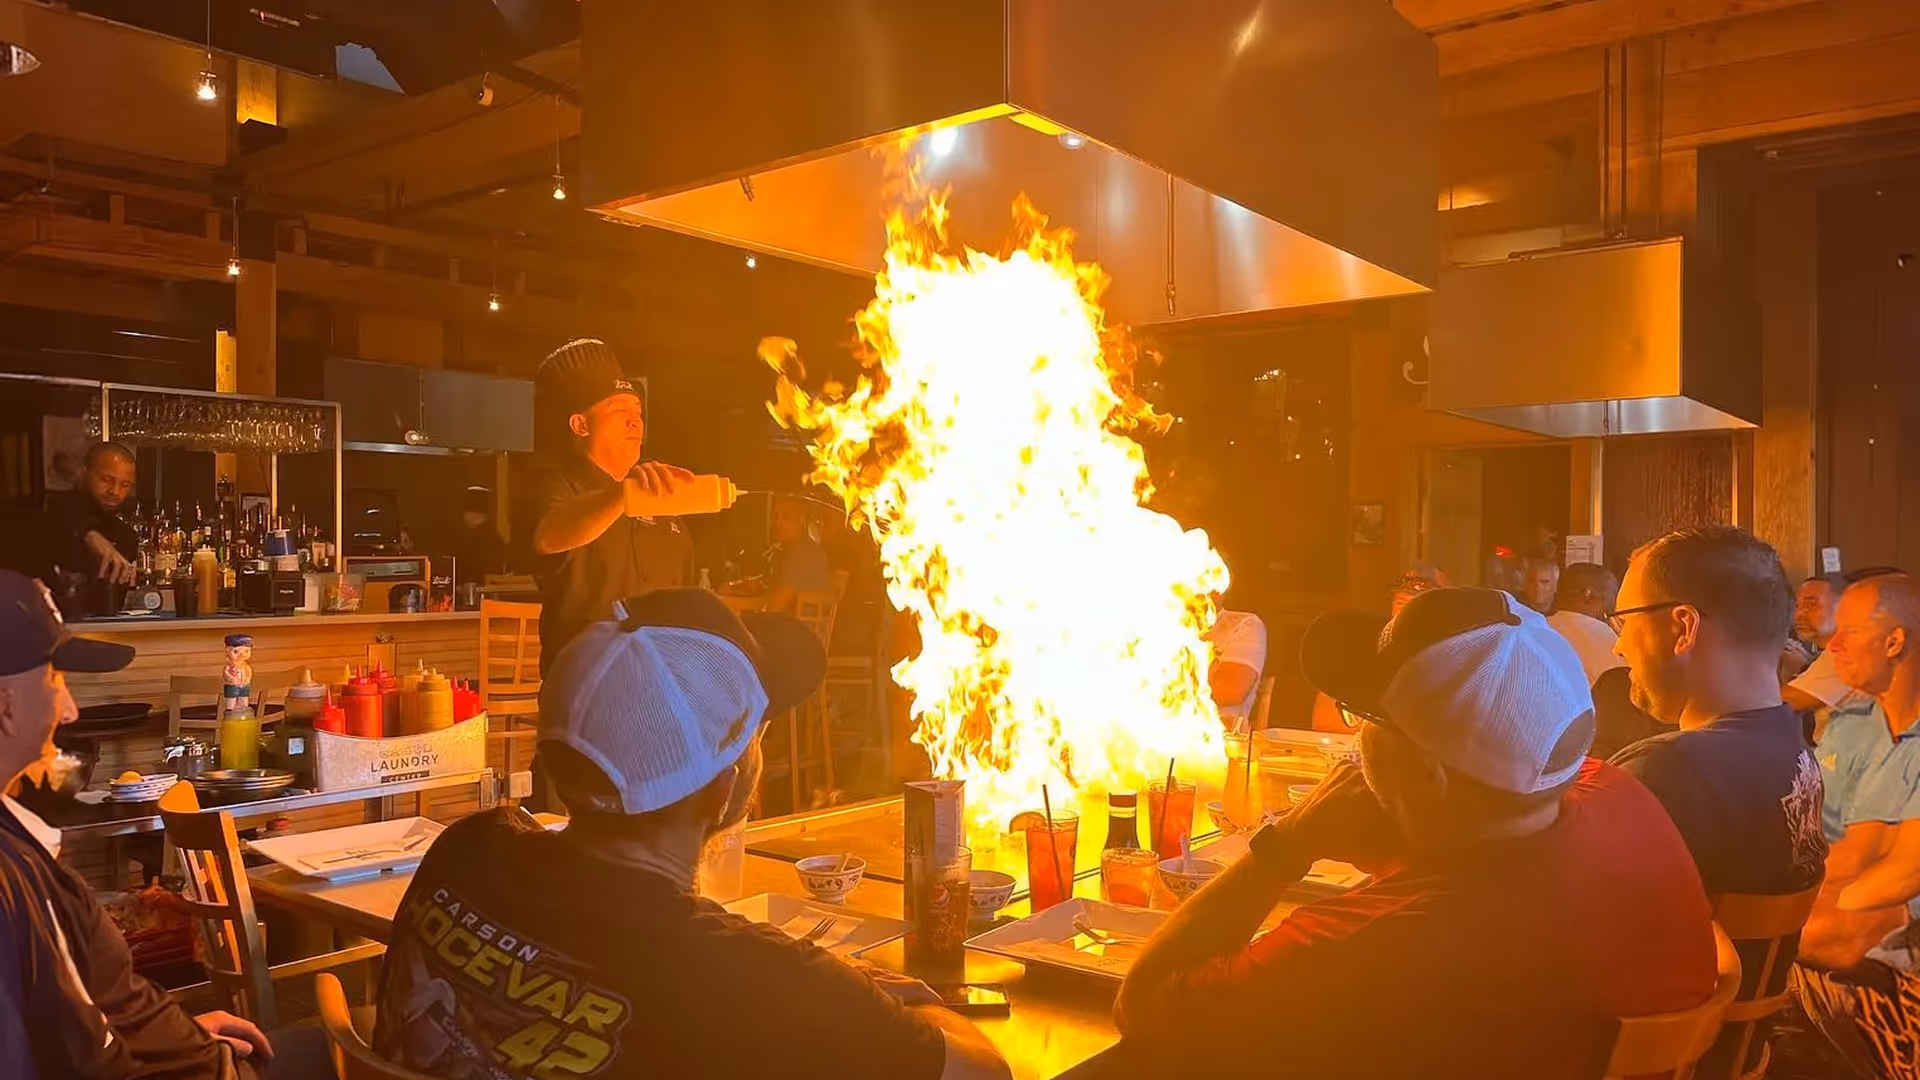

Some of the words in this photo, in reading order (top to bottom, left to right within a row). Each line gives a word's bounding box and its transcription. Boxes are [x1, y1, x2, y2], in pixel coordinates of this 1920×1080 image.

[371, 755, 439, 772] LAUNDRY
[433, 888, 539, 962] CARSON
[405, 898, 623, 1033] HOCEVAR
[497, 1020, 610, 1074] 42
